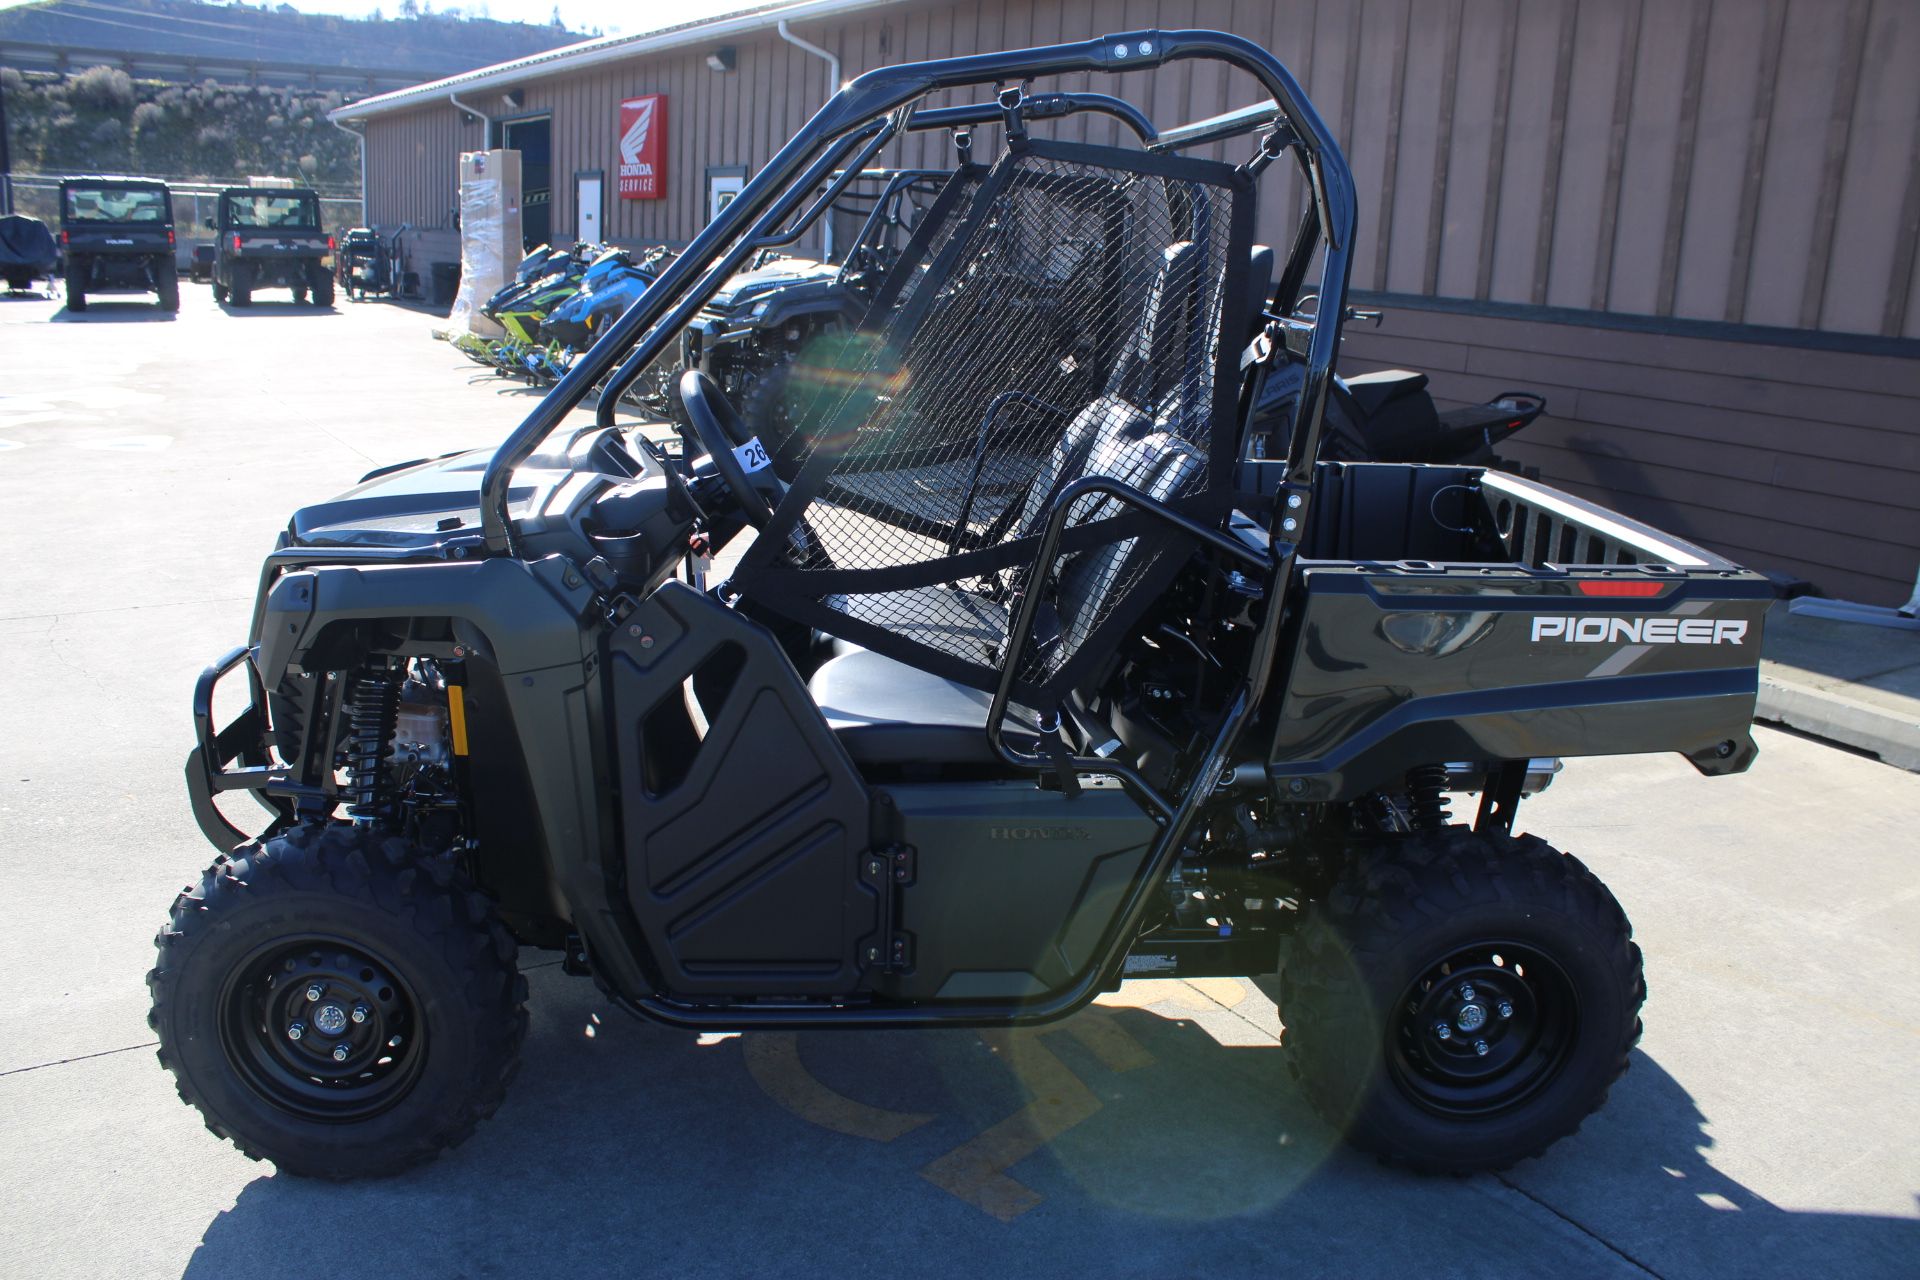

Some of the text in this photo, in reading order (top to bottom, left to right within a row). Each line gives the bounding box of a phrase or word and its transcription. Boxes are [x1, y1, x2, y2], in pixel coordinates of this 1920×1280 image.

[620, 163, 653, 176] HONDA
[620, 178, 653, 192] SERVICE
[1531, 616, 1748, 645] PIONEER
